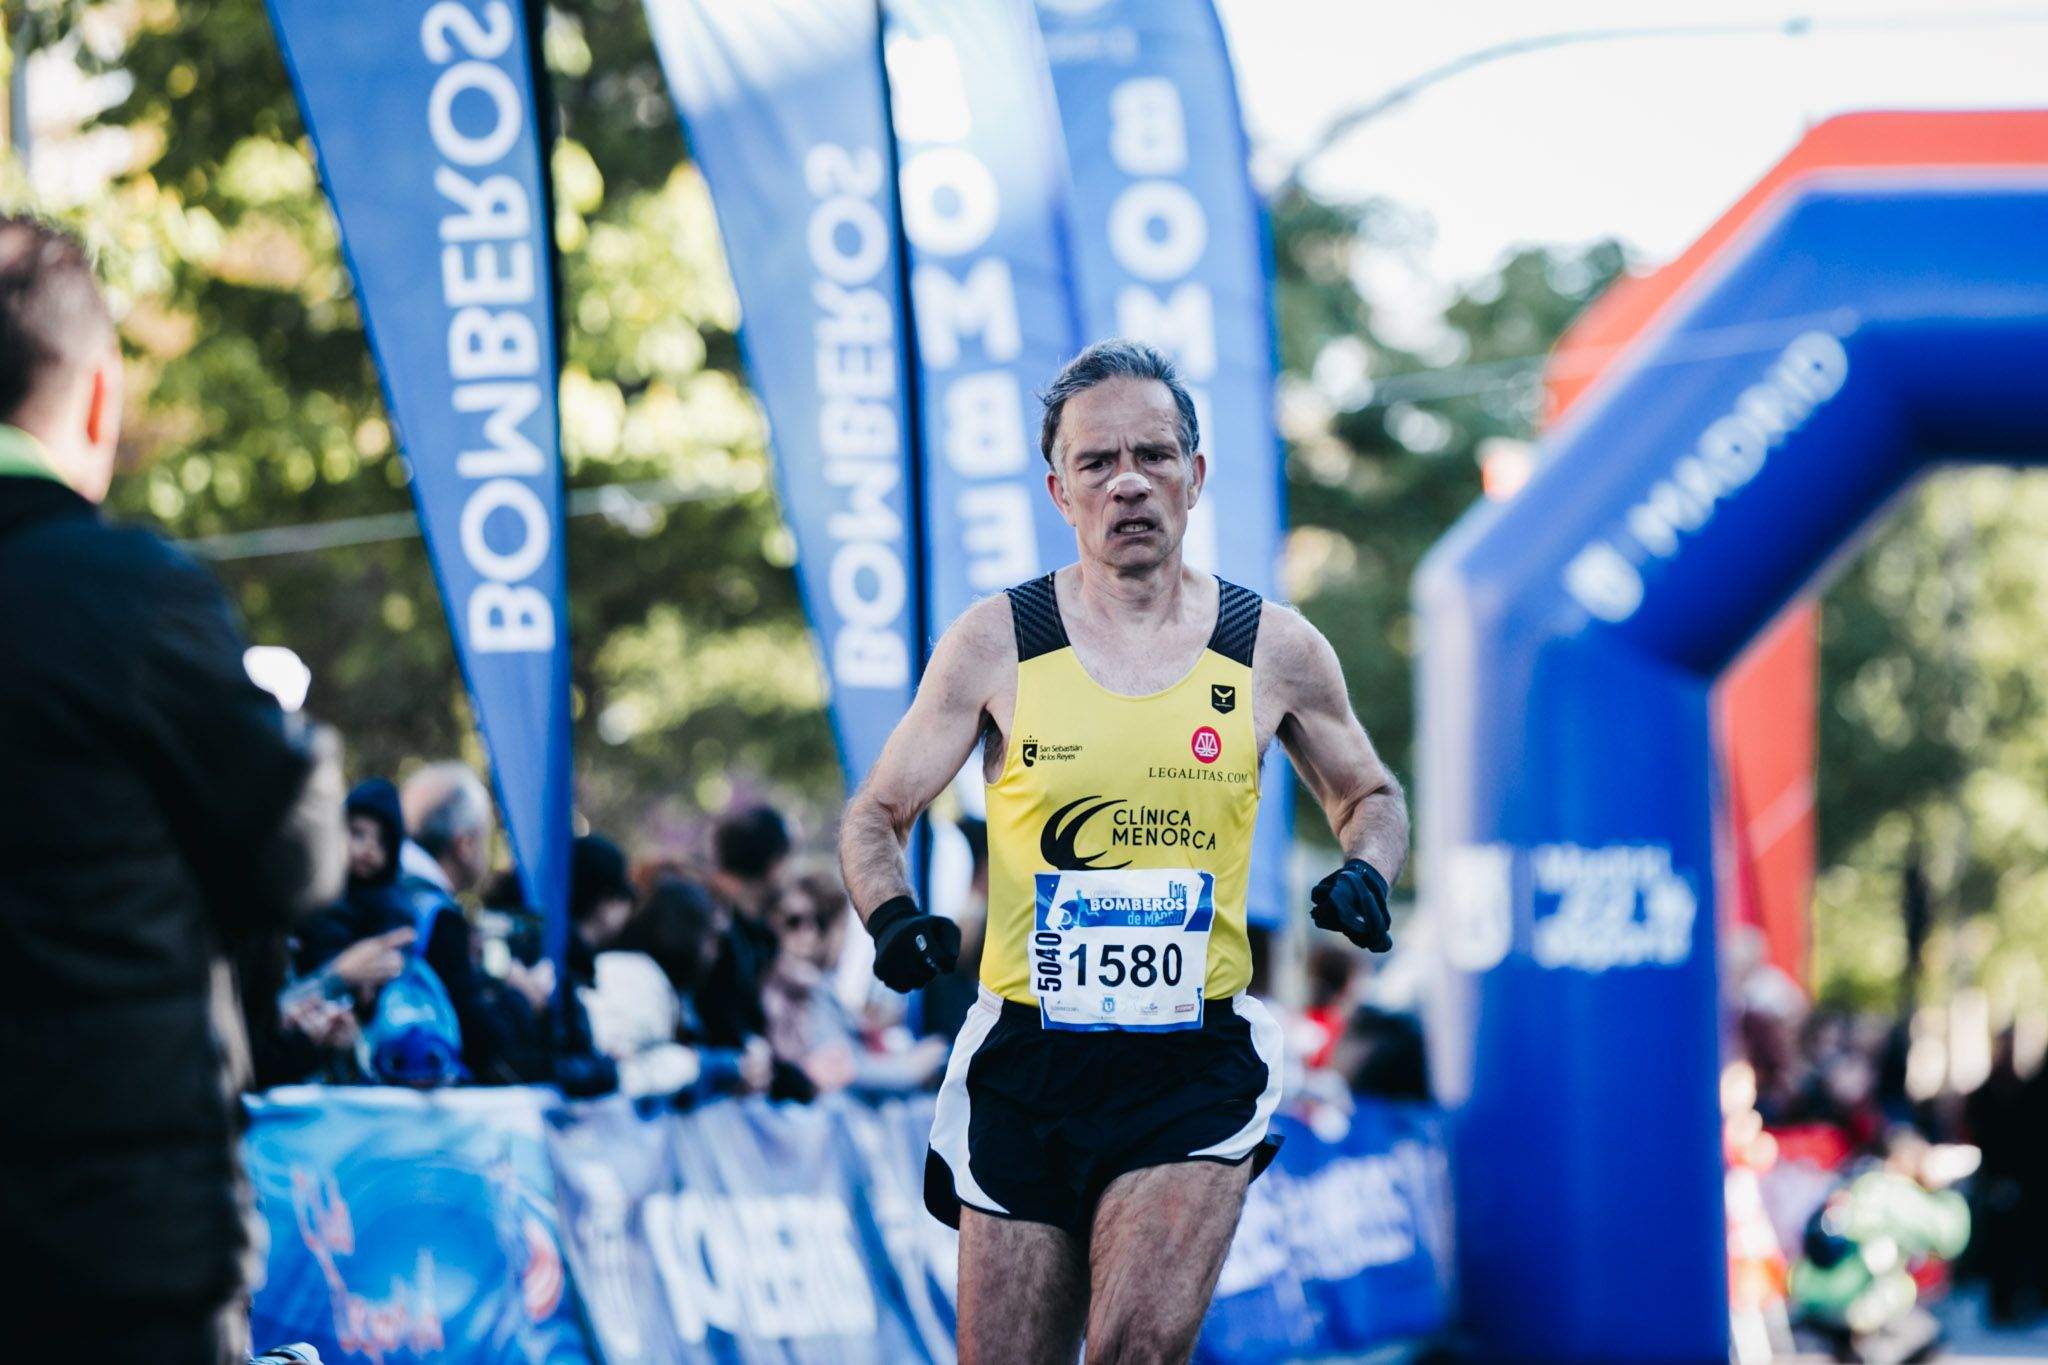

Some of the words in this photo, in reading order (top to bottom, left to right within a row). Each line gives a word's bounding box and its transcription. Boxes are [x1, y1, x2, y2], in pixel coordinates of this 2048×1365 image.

[1148, 766, 1248, 783] LEGALITAS.COM
[1113, 806, 1191, 827] CLÍNICA
[1112, 828, 1216, 850] MENORCA
[1090, 898, 1186, 912] BOMBEROS
[1128, 912, 1141, 925] de
[1035, 932, 1063, 992] 5040
[1069, 943, 1183, 987] 1580
